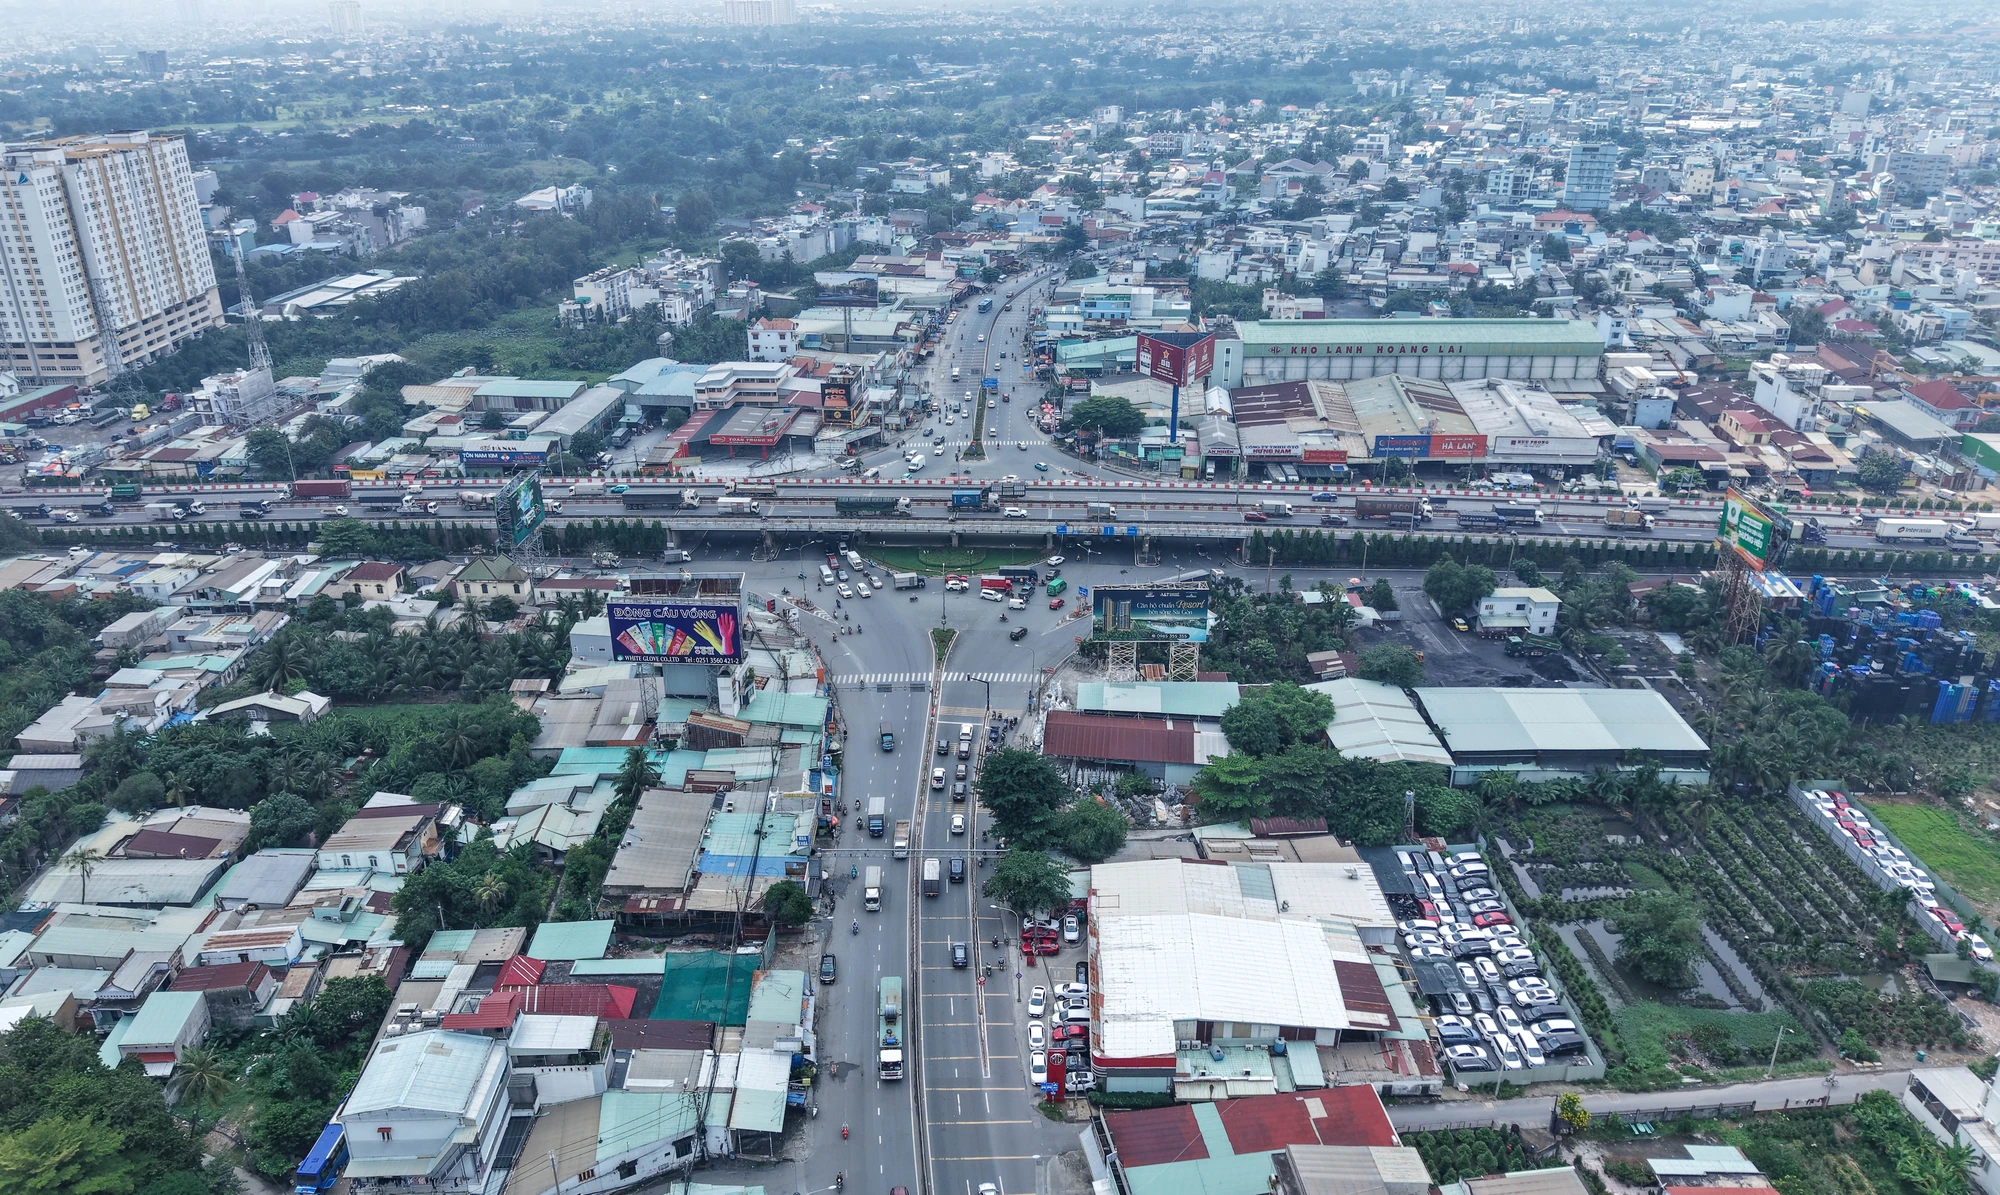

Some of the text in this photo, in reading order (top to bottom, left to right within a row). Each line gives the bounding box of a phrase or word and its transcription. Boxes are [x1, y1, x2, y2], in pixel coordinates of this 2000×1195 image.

[1291, 346, 1318, 354] KHO
[1327, 346, 1363, 356] LẠNH
[1377, 344, 1429, 354] HOÀNG
[1176, 600, 1205, 610] Resort
